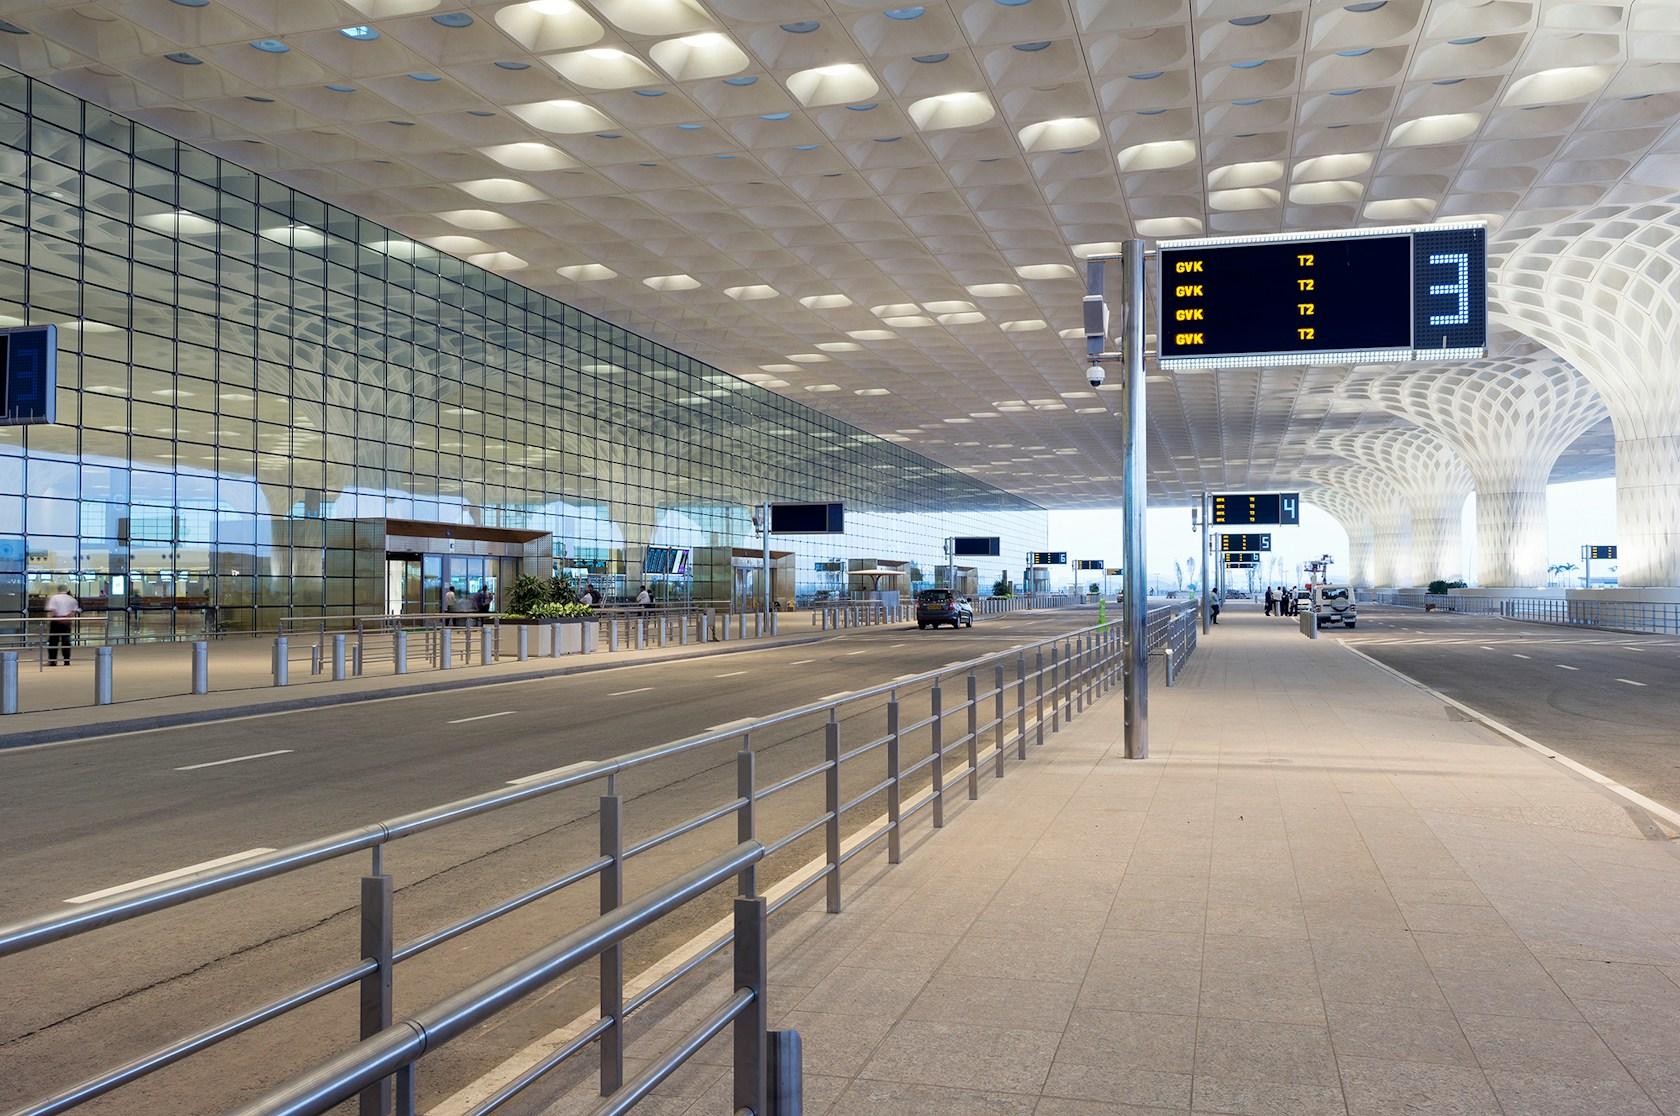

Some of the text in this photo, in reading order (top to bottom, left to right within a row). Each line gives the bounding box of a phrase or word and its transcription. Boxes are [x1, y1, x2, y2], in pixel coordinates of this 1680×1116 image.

[1176, 255, 1314, 273] GVK T2
[1176, 279, 1314, 297] GVK T2
[1429, 253, 1469, 326] 3
[1176, 304, 1314, 321] GVK T2
[1176, 328, 1314, 345] GVK T2
[1284, 499, 1295, 518] 4
[1262, 536, 1269, 549] 5
